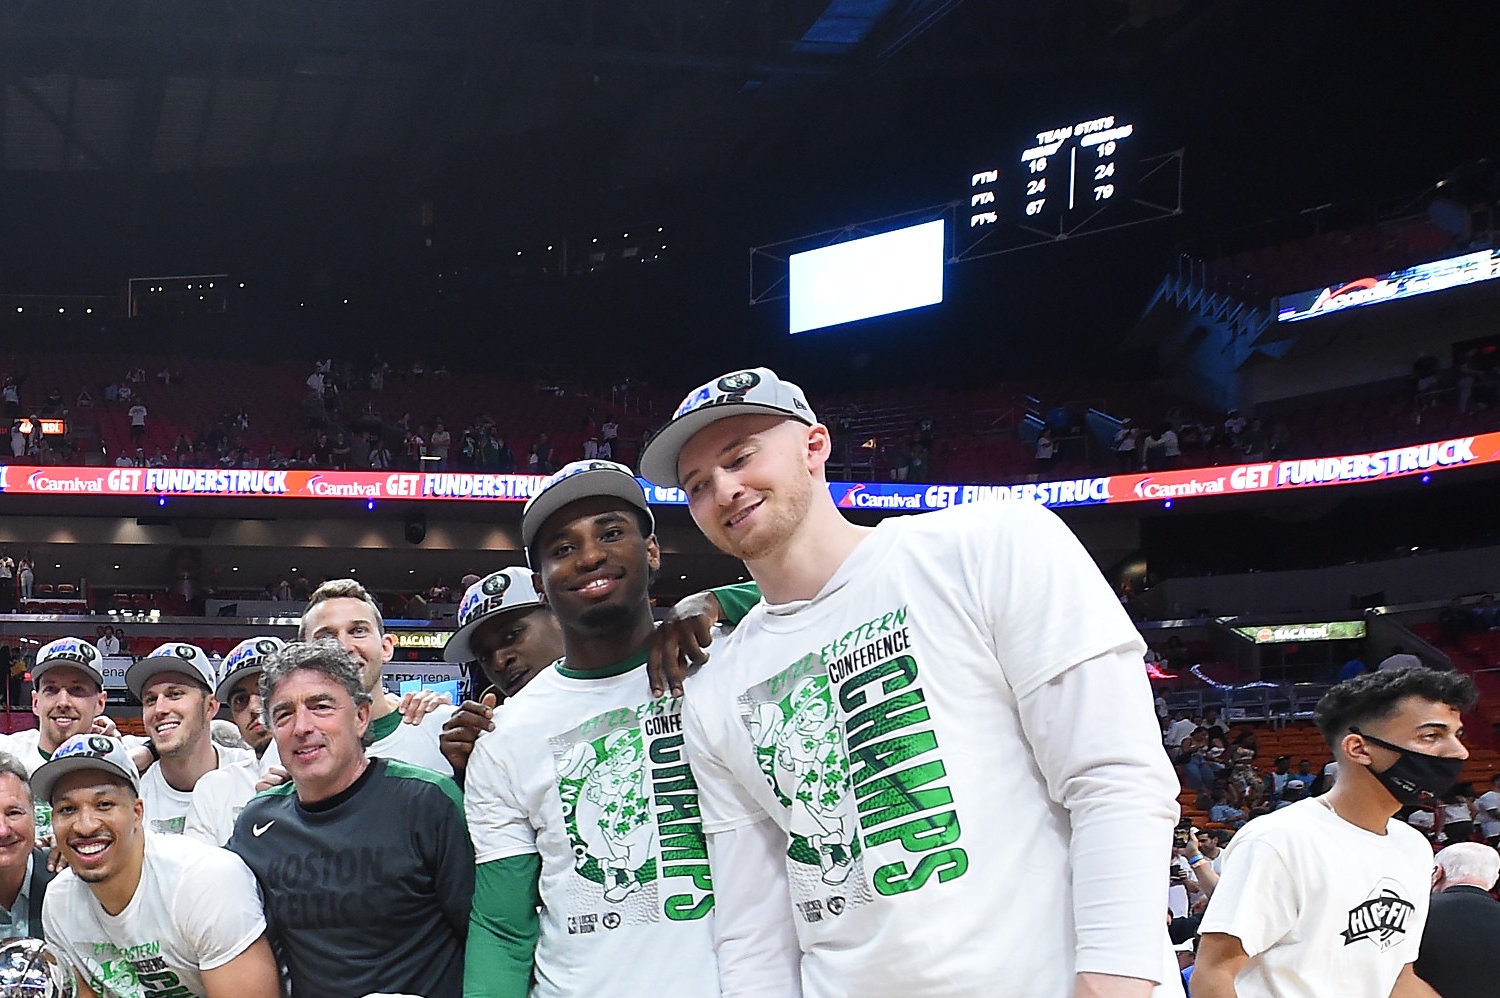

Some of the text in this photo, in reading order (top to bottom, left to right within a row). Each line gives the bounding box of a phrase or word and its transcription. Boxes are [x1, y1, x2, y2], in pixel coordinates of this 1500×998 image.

[1036, 126, 1073, 145] TEAM
[1074, 116, 1115, 136] STATS
[971, 162, 1115, 207] FTA 24 24
[1025, 199, 1046, 216] 67
[1145, 437, 1476, 498] Carnival GET FUNDERSTRUCK
[36, 469, 287, 493] Carnival GET FUNDERSTRUCK
[314, 474, 544, 499] Carnival GET FUNDERSTRU
[856, 493, 921, 508] Carnival
[924, 486, 959, 508] GET
[819, 604, 909, 666] EASTERN
[828, 627, 912, 685] CONFERENCE
[102, 668, 125, 677] ena
[635, 696, 684, 721] EAST
[645, 713, 683, 736] CONFE
[839, 654, 970, 897] CHAMPS
